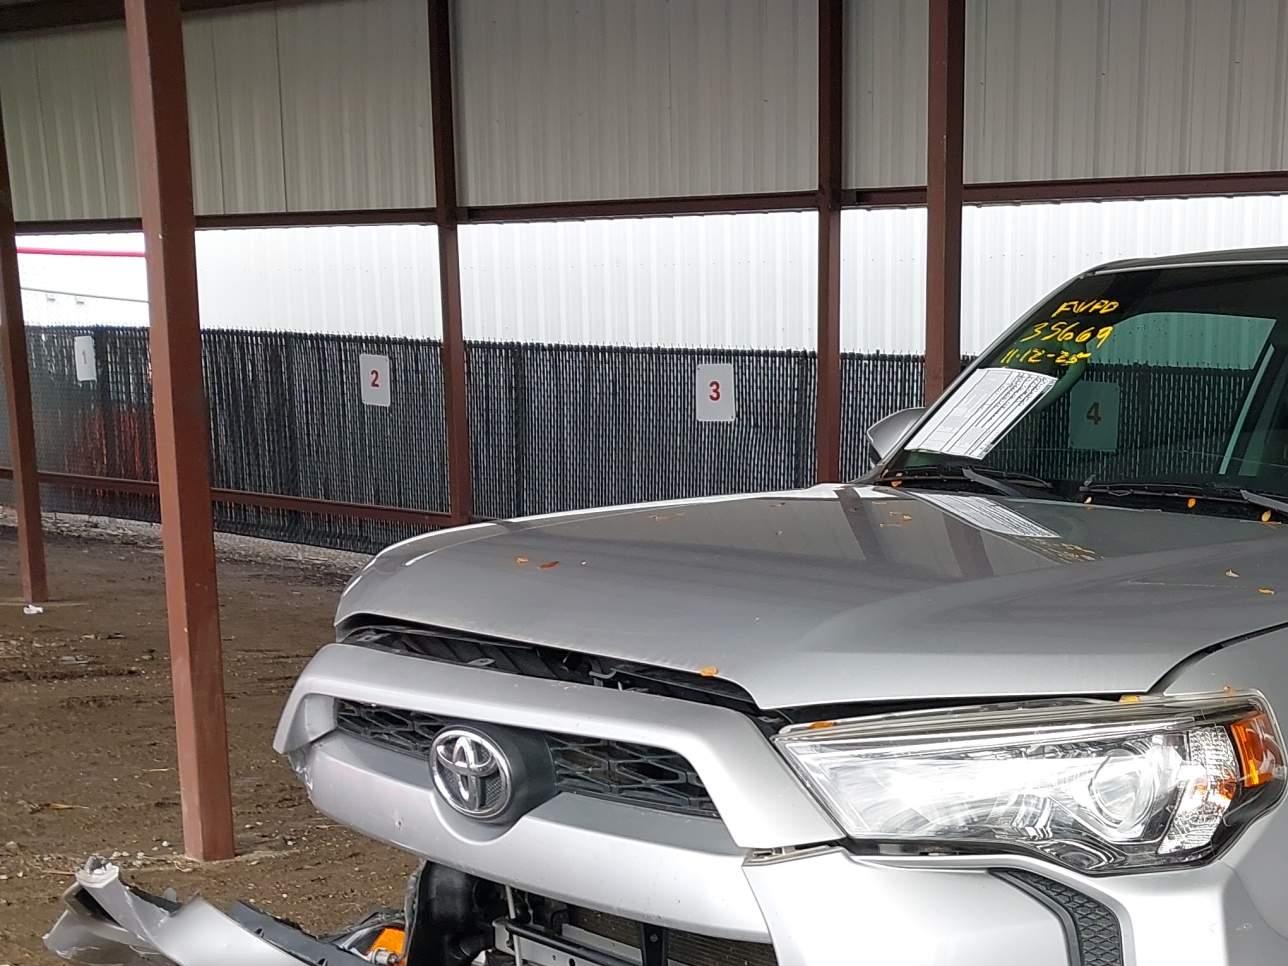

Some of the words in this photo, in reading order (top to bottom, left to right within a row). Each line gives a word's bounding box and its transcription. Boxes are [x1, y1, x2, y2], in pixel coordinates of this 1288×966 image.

[370, 369, 380, 388] 2
[709, 380, 721, 401] 3
[1086, 402, 1102, 425] 4
